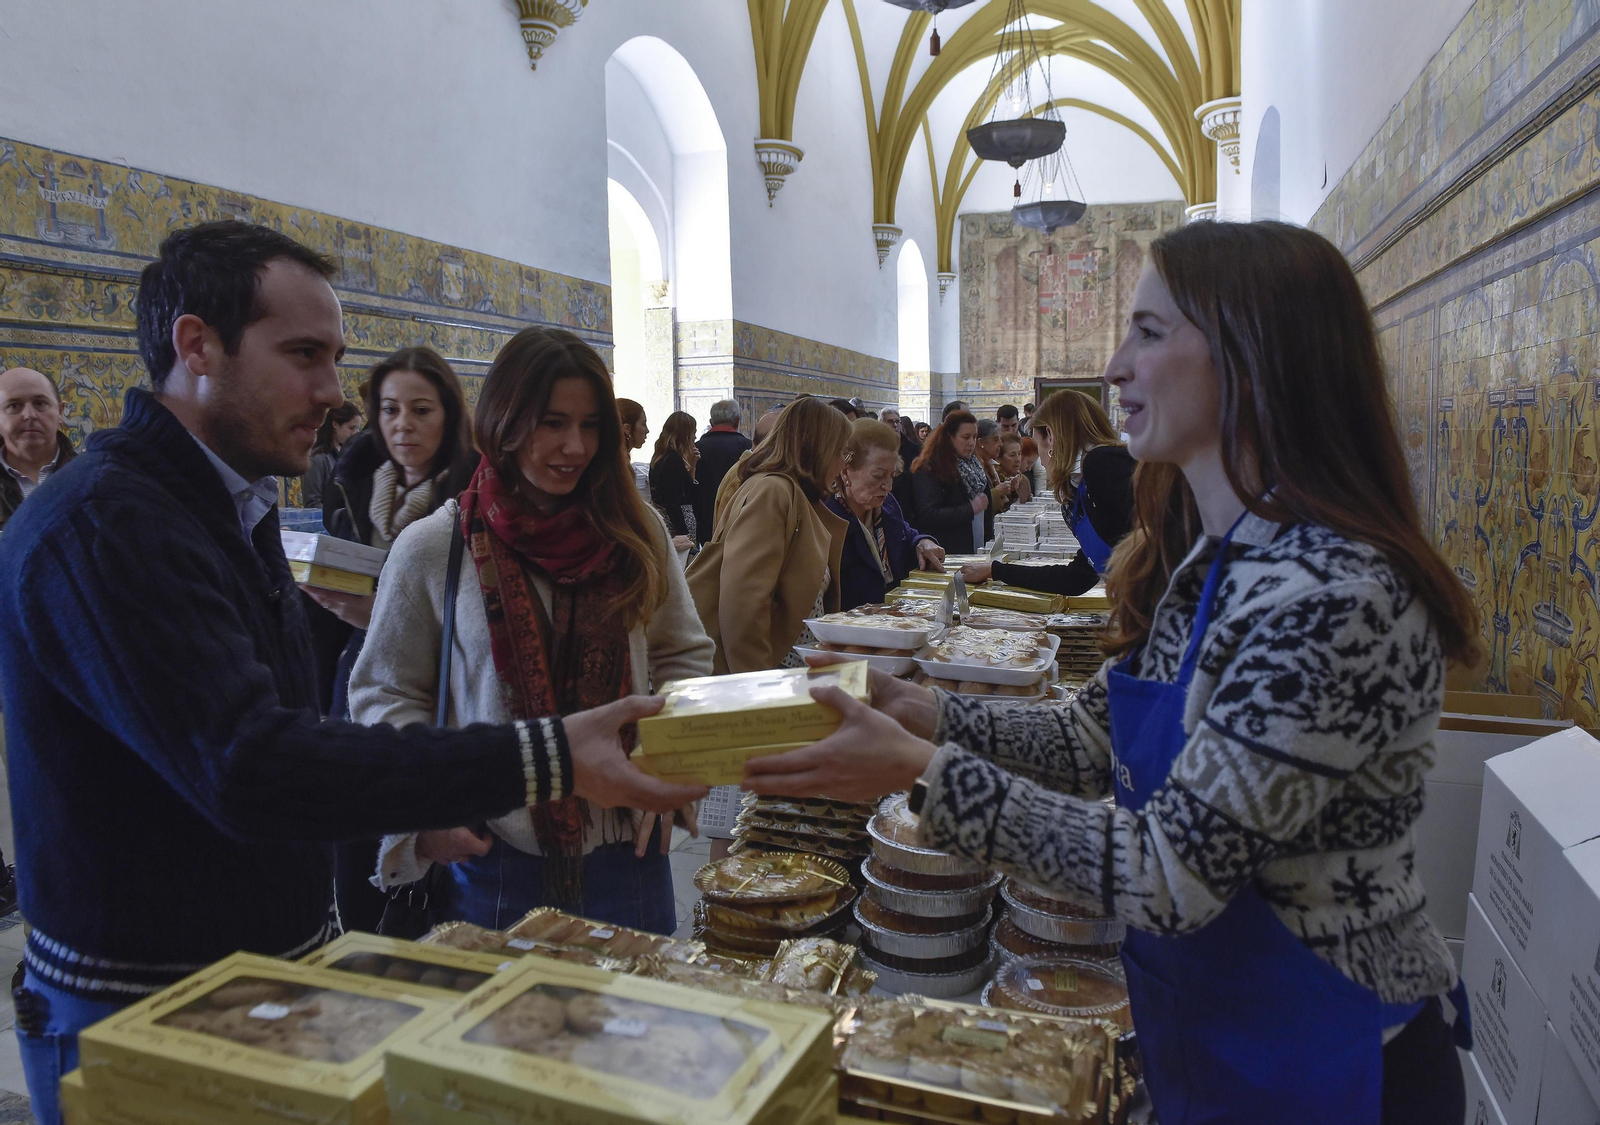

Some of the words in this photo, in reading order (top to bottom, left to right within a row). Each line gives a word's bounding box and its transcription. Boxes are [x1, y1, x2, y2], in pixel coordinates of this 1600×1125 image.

[681, 719, 739, 733] Monasterio
[742, 717, 754, 729] de
[756, 712, 787, 726] Santa
